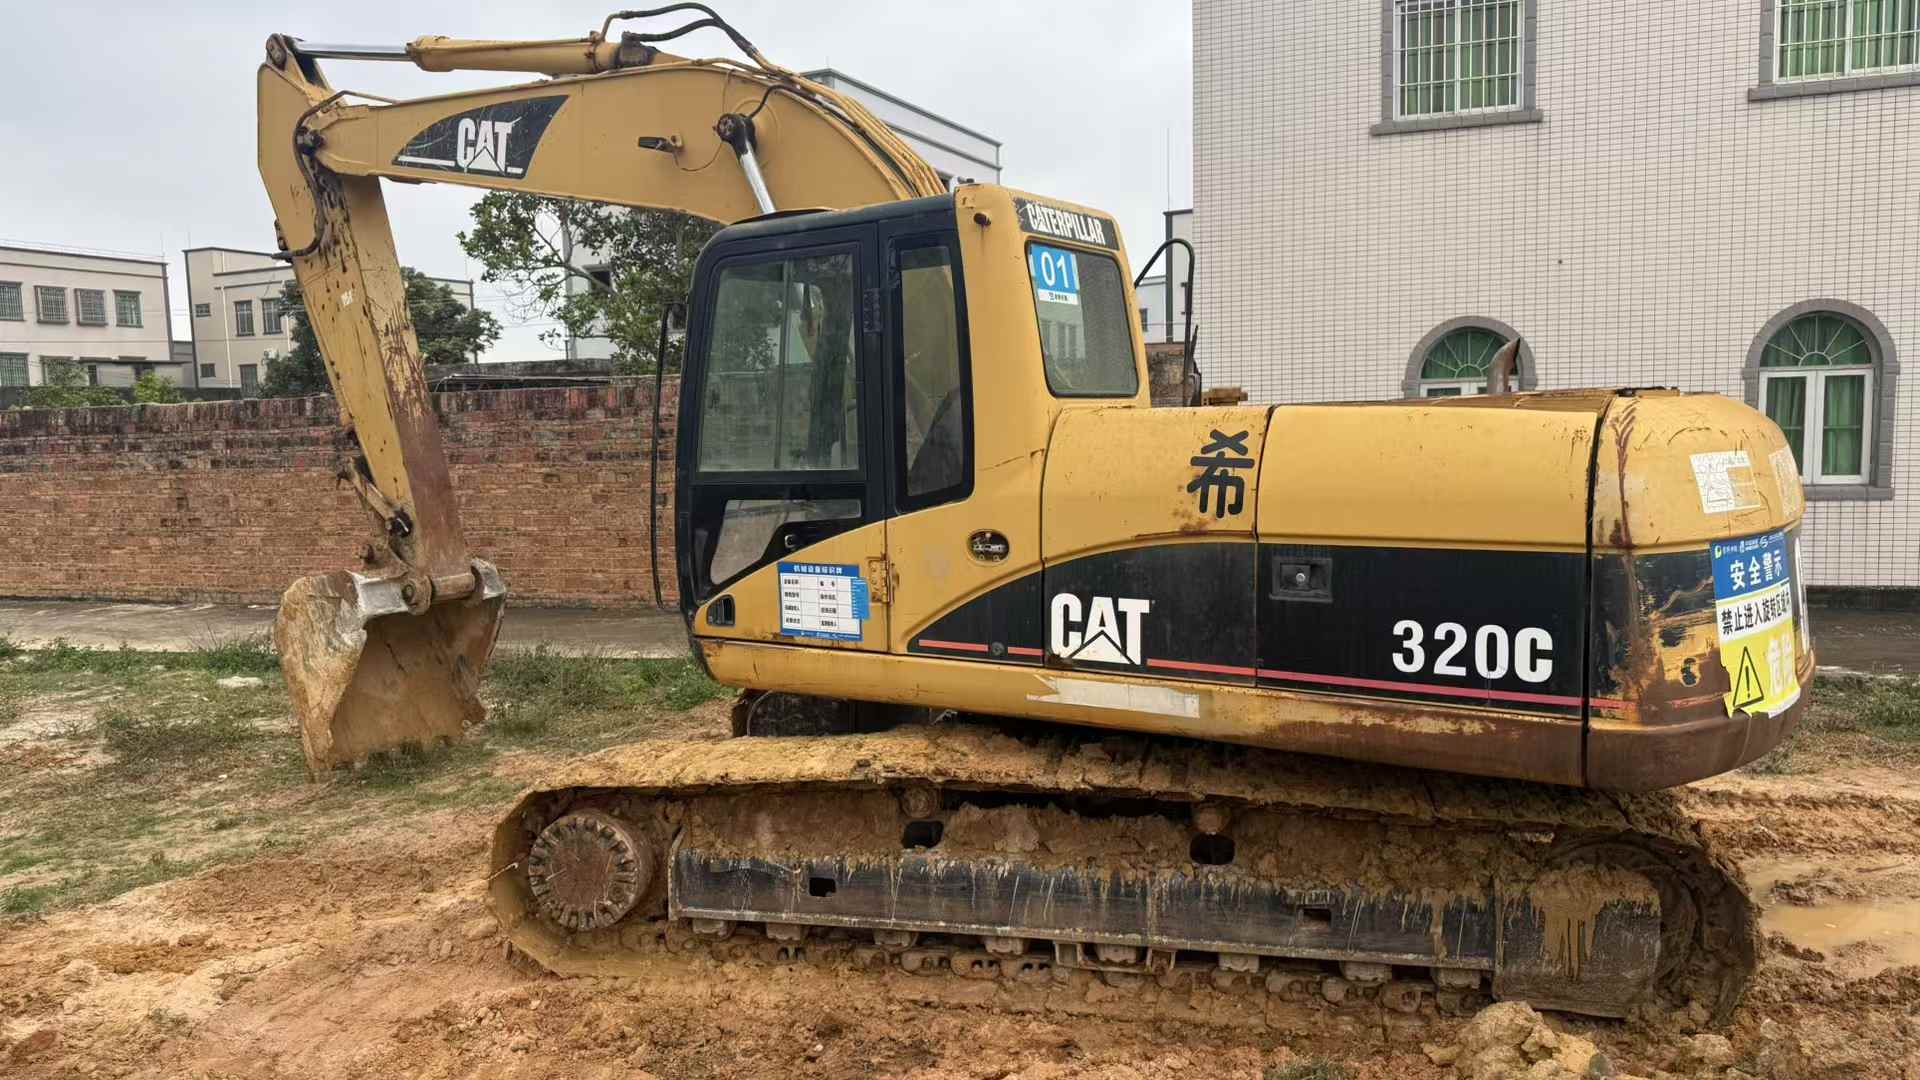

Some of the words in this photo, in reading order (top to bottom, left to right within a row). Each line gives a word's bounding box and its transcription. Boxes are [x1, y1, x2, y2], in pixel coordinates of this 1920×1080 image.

[457, 118, 512, 173] CAT
[1026, 203, 1106, 245] CATERPILLAR
[1041, 251, 1069, 289] 01
[1187, 429, 1255, 518] 希
[1730, 549, 1783, 590] 安全警示
[1051, 593, 1150, 665] CAT
[1392, 619, 1553, 683] 320C
